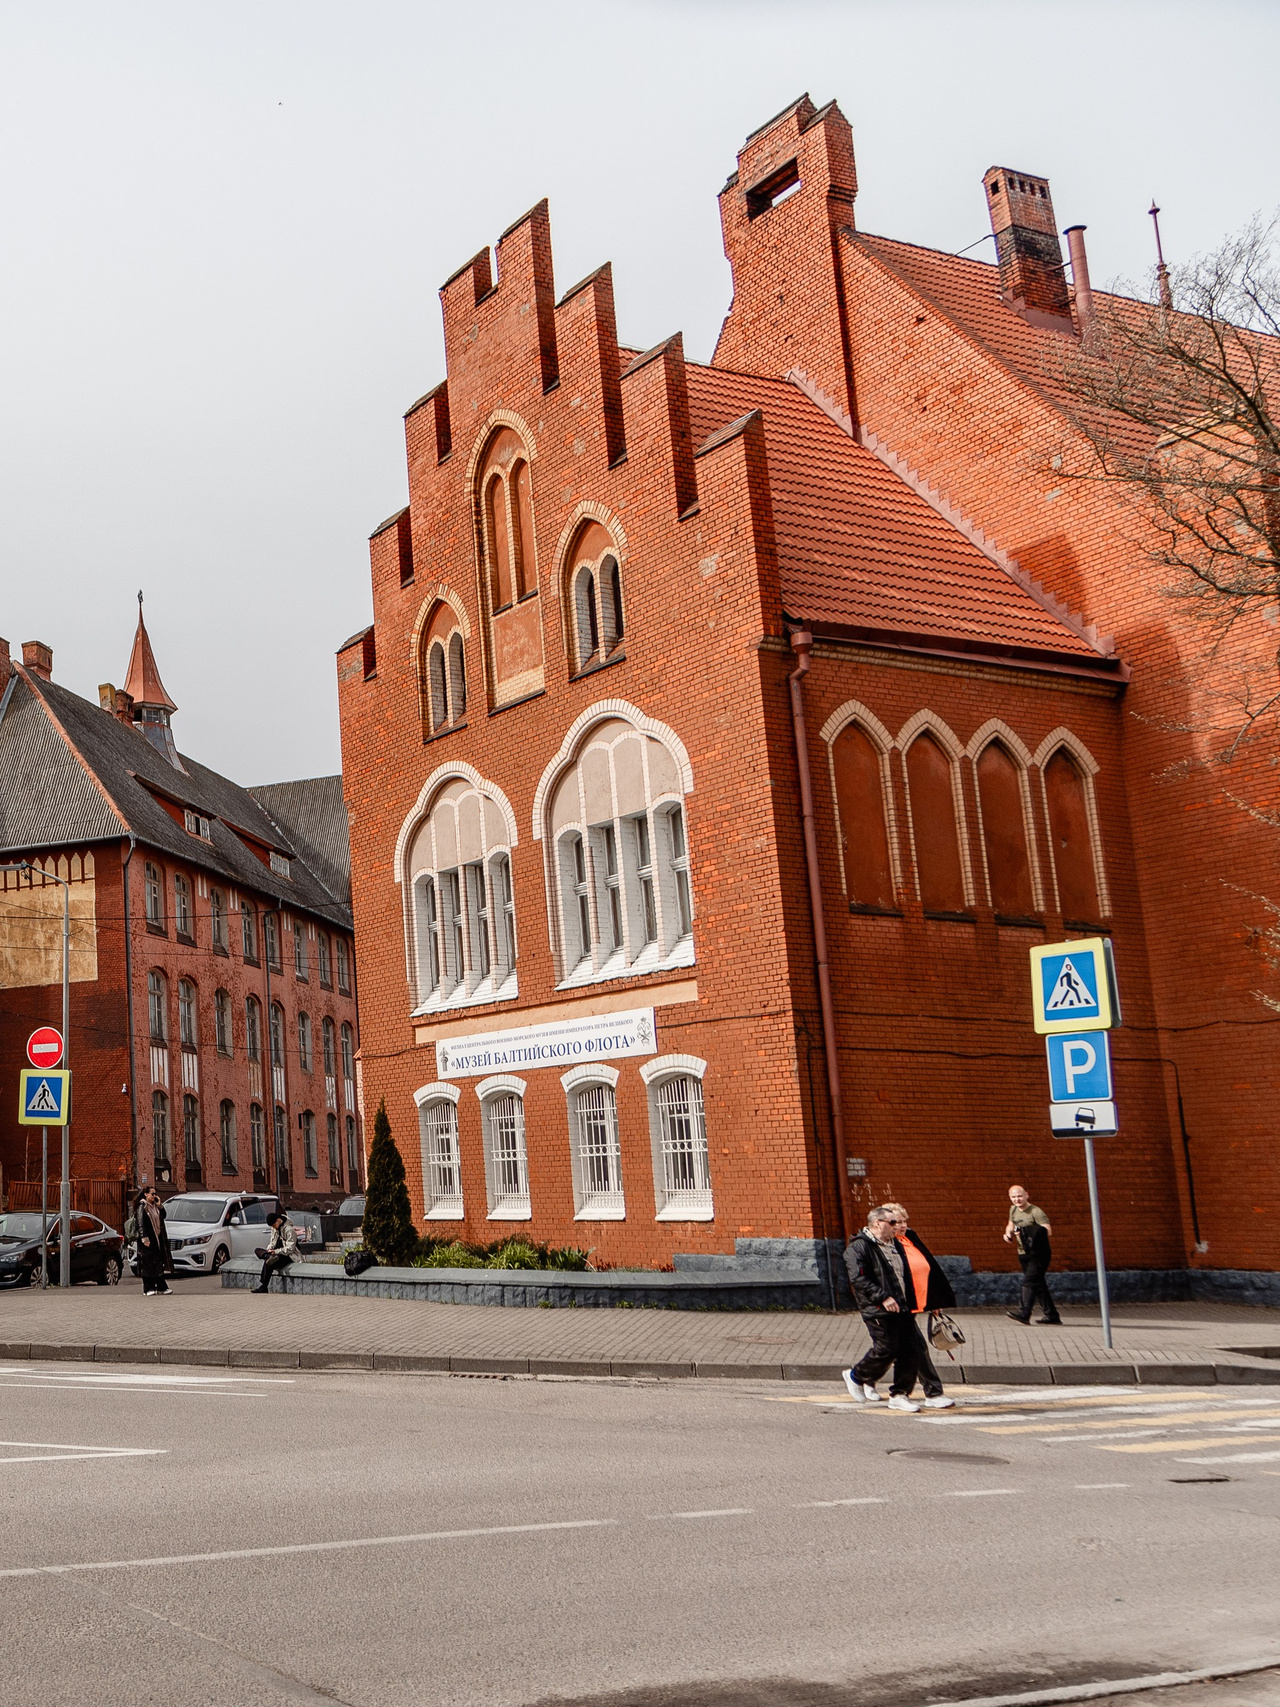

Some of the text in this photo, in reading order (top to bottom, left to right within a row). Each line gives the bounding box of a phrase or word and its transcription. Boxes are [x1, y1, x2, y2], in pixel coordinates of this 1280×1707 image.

[450, 1034, 636, 1070] «МУЗЕЙ БАЛТИЙСКОГО ФЛОТА»
[1062, 1039, 1097, 1094] P
